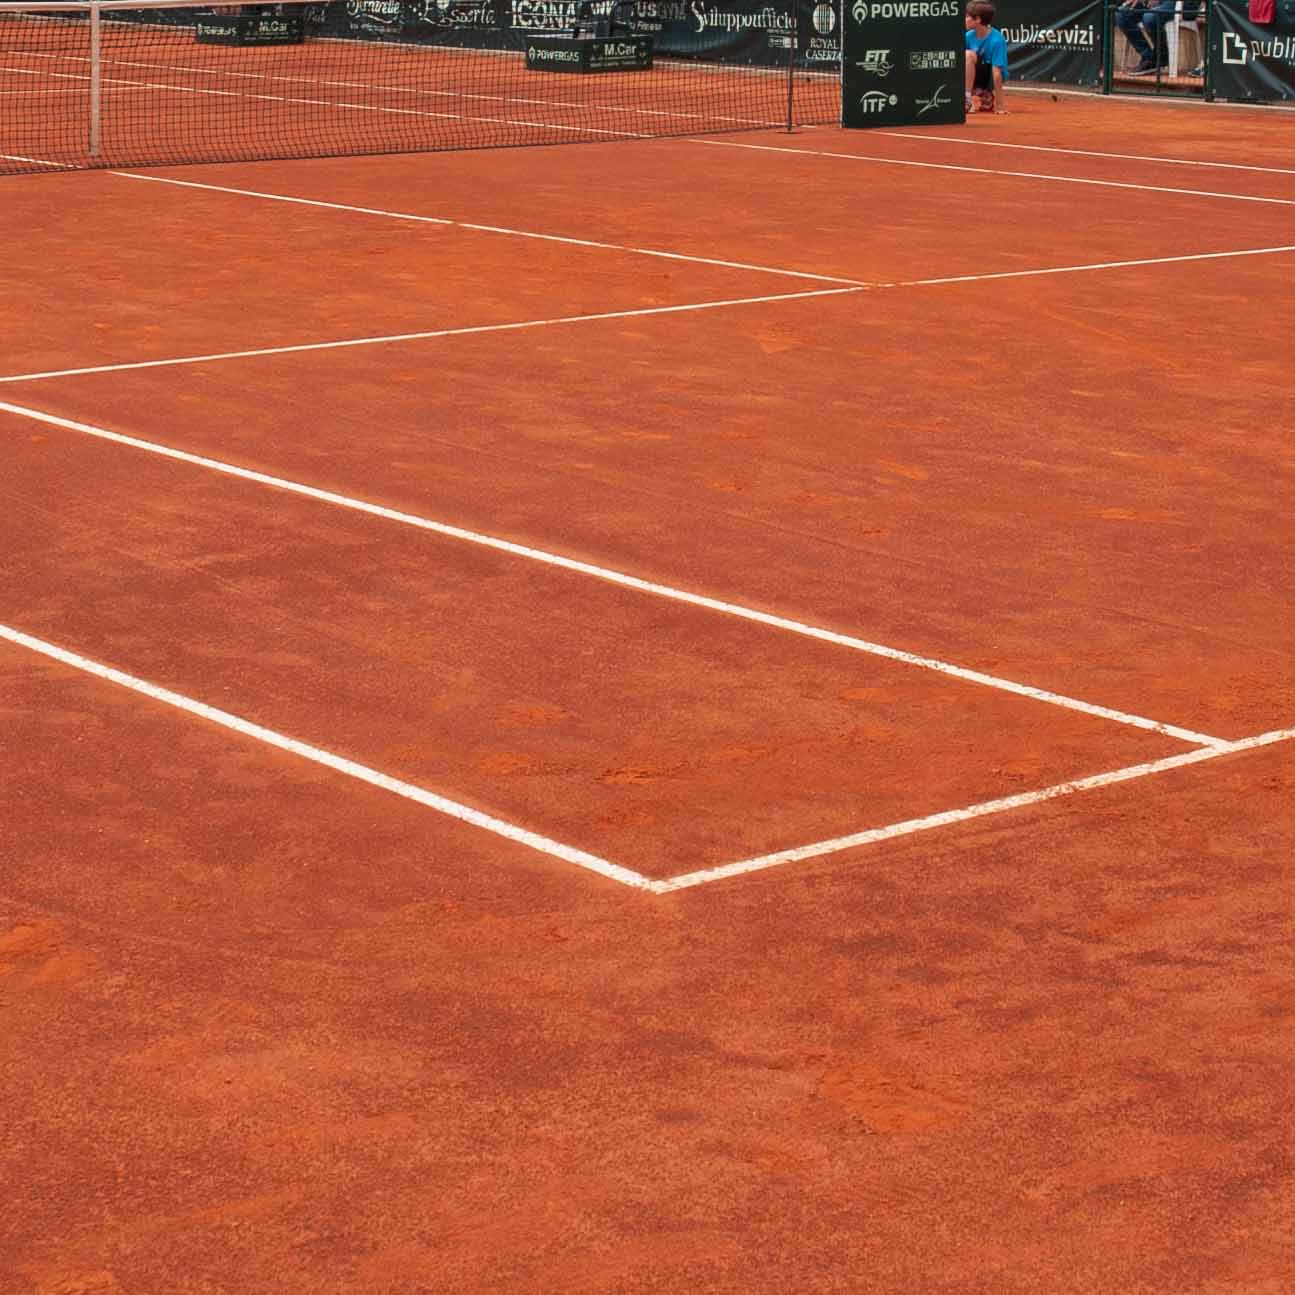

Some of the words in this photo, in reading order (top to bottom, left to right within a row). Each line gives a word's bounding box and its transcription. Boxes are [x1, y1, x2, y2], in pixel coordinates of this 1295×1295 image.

[871, 0, 959, 19] POWERGAS
[604, 43, 638, 56] M.Car
[864, 49, 891, 63] FIT
[862, 98, 887, 113] ITF
